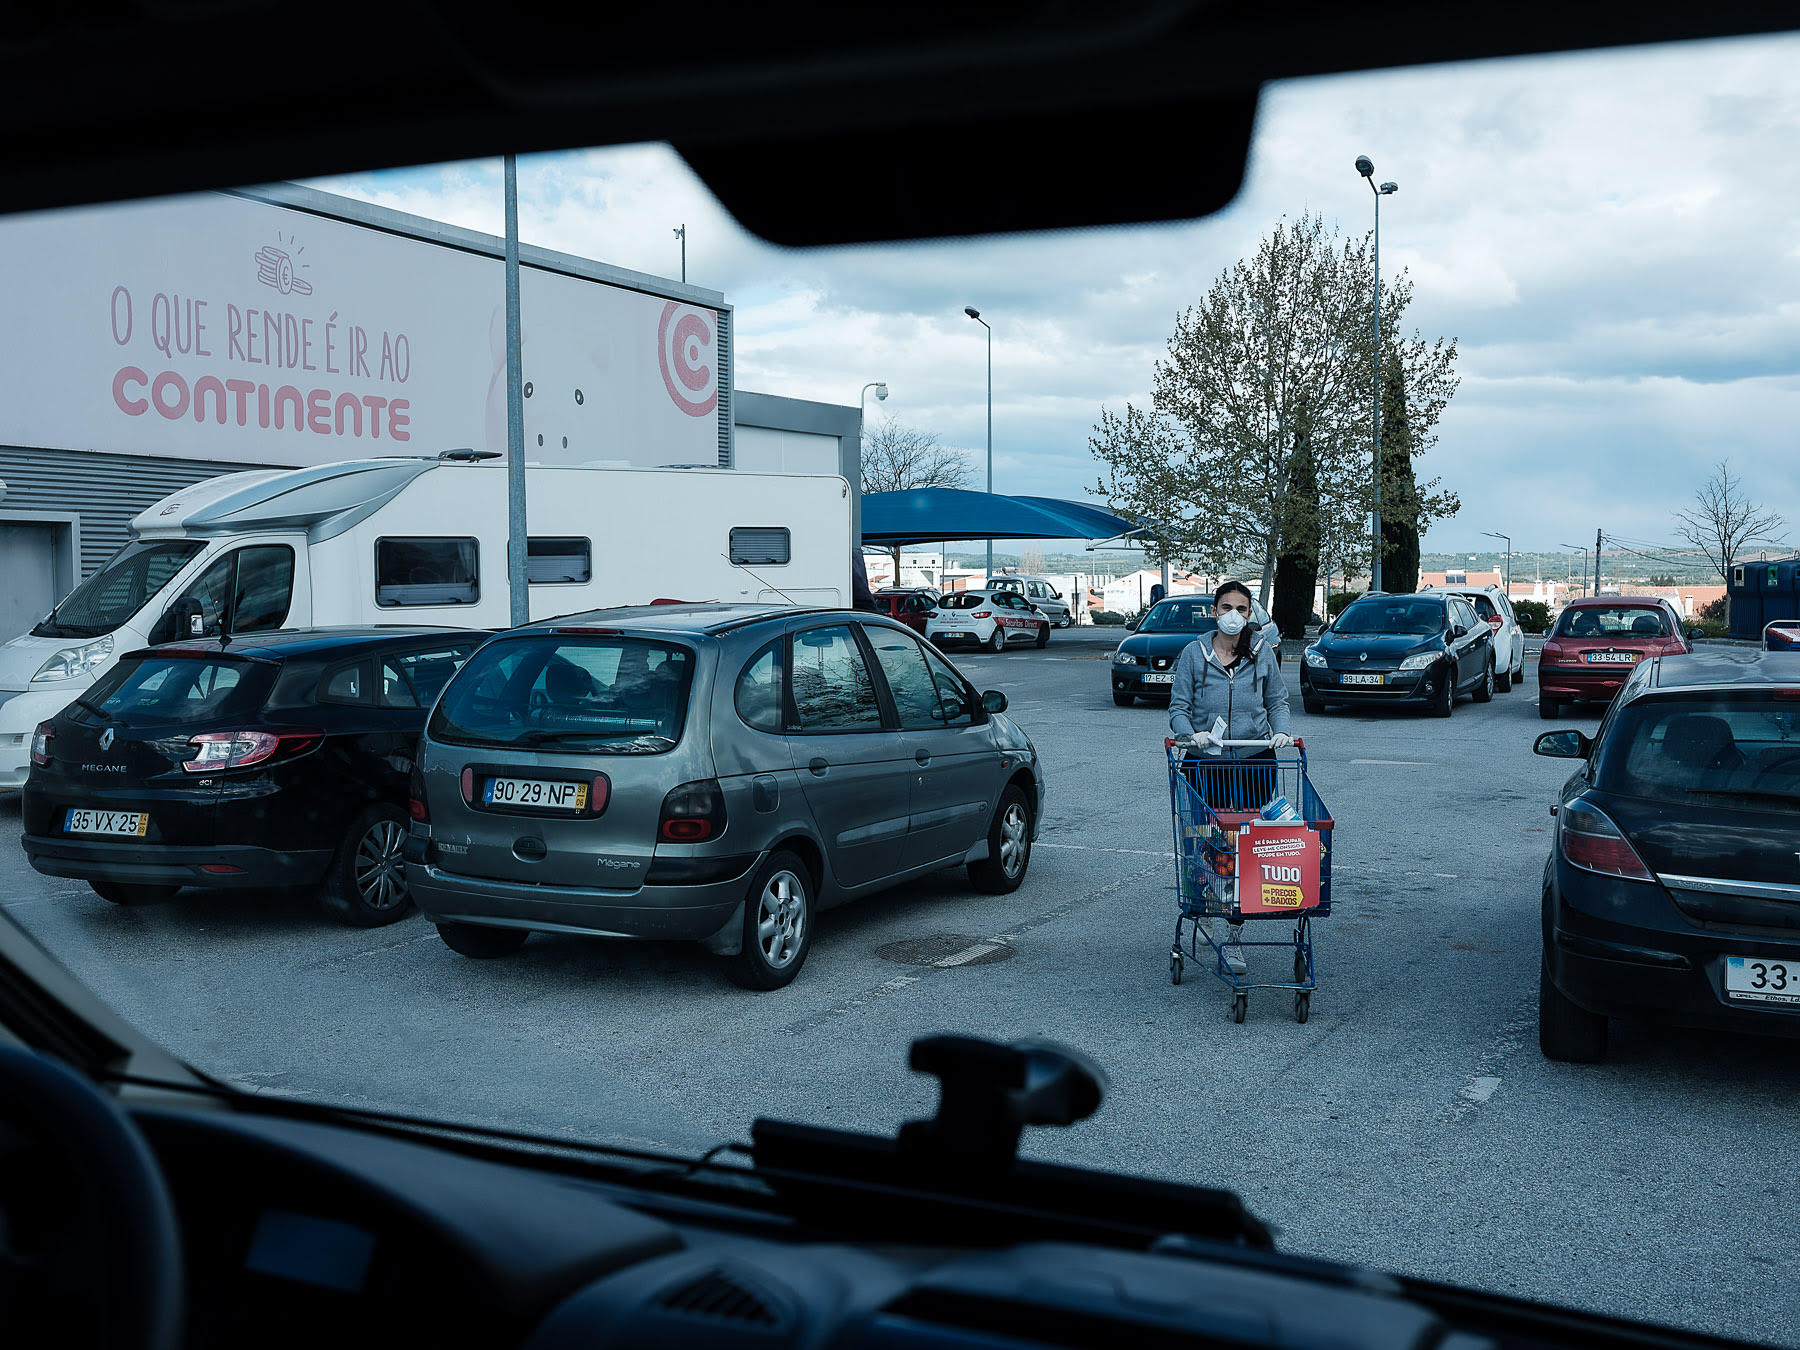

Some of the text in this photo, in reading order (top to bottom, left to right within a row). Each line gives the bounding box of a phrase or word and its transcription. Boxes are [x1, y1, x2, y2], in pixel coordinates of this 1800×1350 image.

[111, 285, 410, 384] O QUE RENDE É IR AO
[112, 365, 411, 442] CONTINENTE
[1145, 674, 1175, 683] 17·EZ·8
[82, 763, 128, 774] MEGANE
[1261, 864, 1300, 882] TUDO
[1270, 888, 1297, 898] PREÇOS
[1270, 896, 1298, 906] BAIXOS
